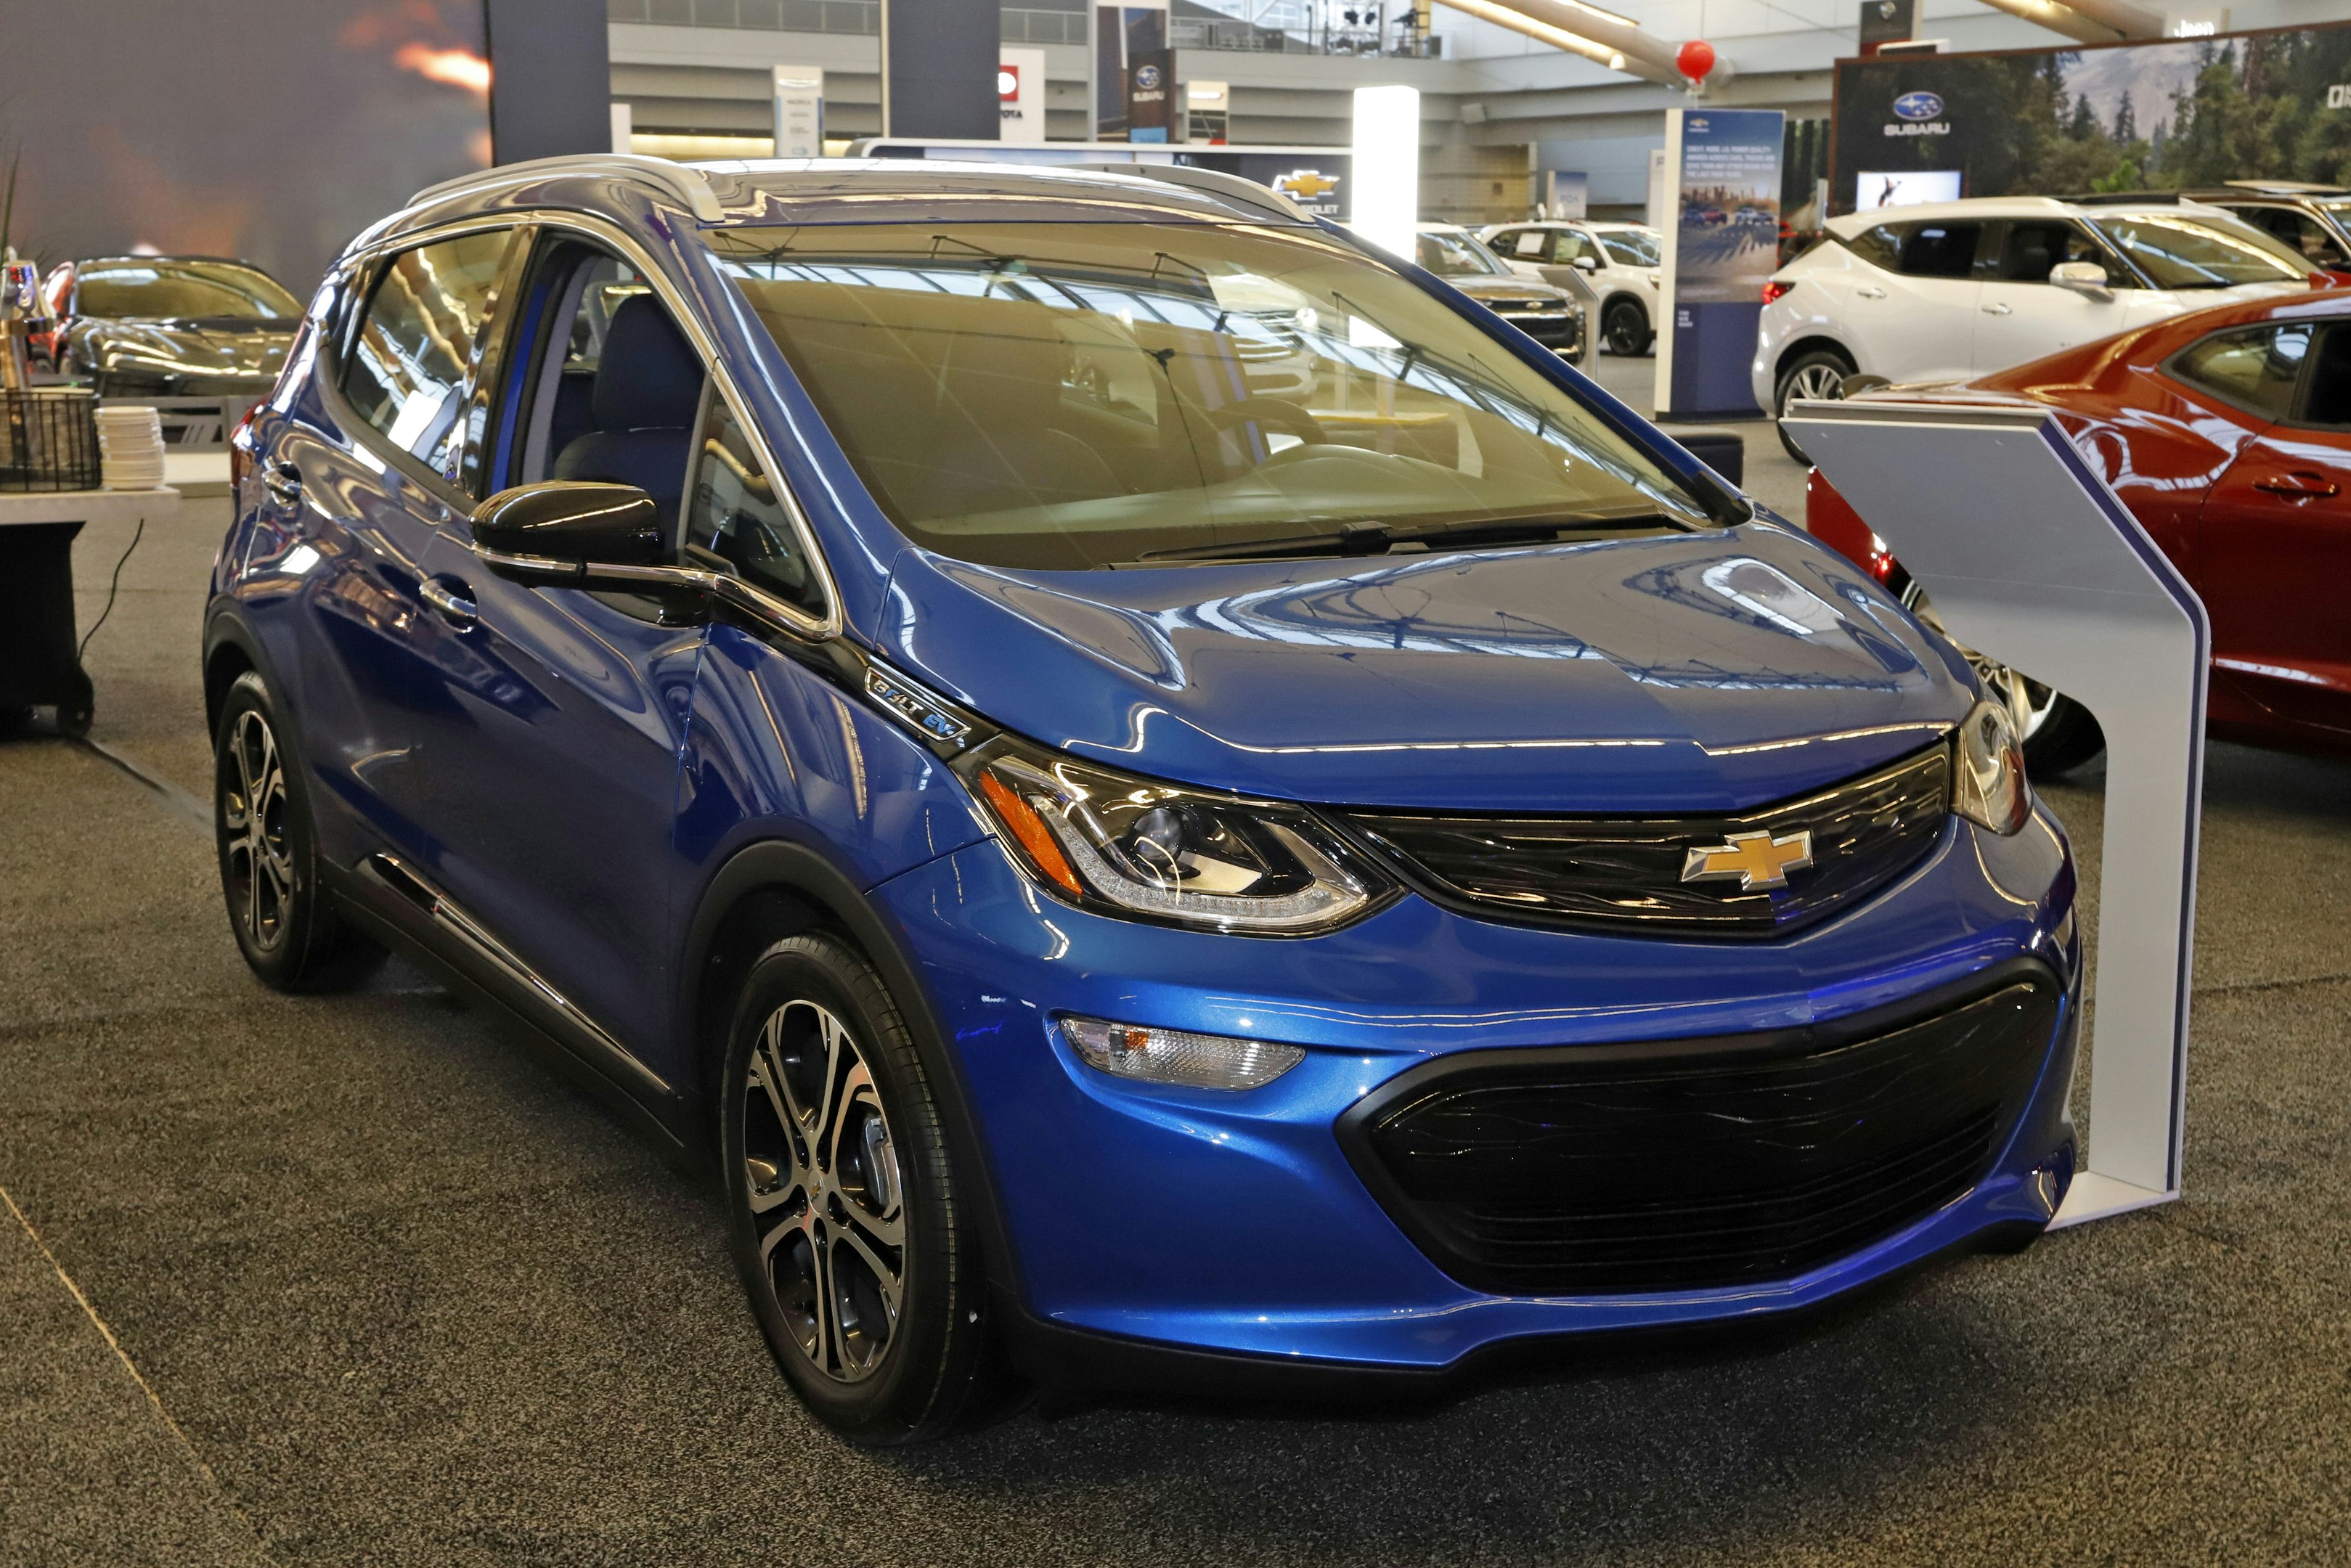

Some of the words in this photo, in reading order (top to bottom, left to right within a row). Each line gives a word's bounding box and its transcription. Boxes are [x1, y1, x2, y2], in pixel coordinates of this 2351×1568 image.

[1883, 122, 1950, 136] SUBARU
[873, 679, 924, 716] BOLT
[922, 714, 956, 735] EV
